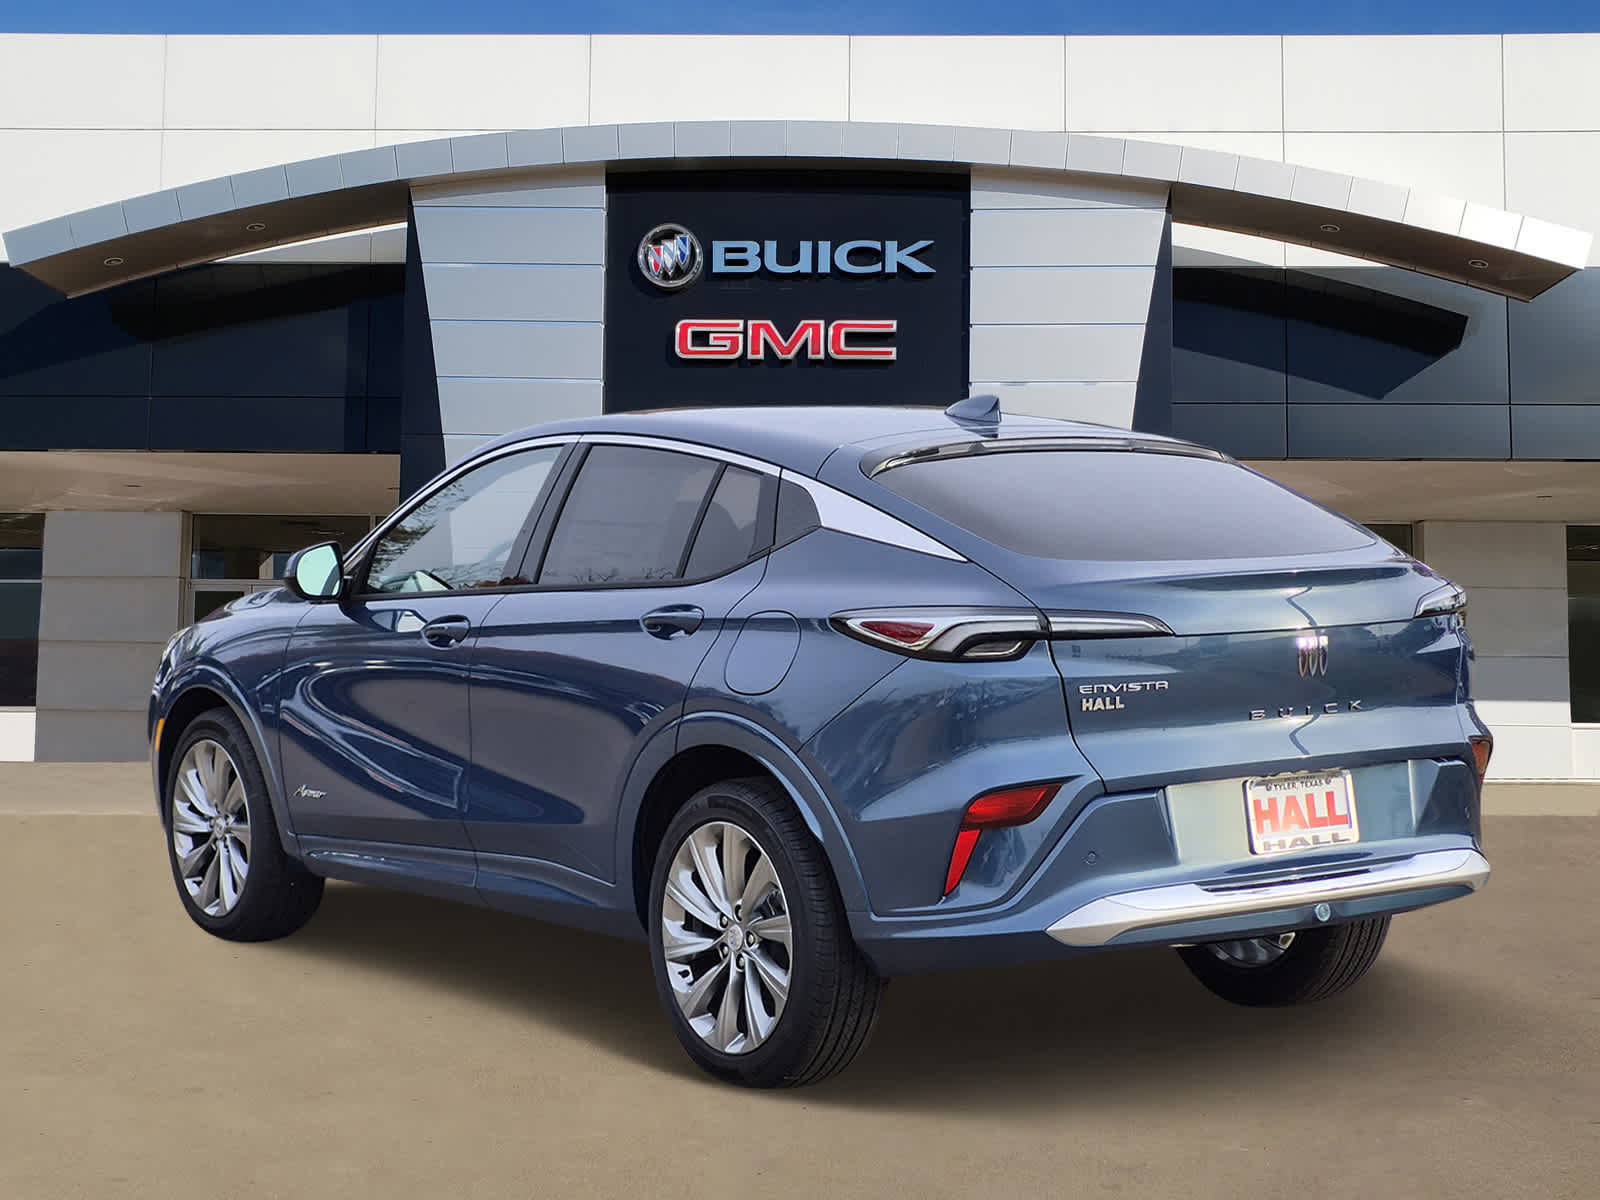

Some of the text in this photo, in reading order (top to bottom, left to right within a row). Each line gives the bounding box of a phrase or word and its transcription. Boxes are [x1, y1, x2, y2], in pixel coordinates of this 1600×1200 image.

[712, 240, 936, 273] BUICK
[674, 319, 897, 360] GMC
[1079, 680, 1168, 694] ENVISTA
[1081, 696, 1125, 711] HALL
[1249, 699, 1362, 720] BUICK
[1300, 779, 1322, 788] TEXAS
[1253, 791, 1348, 834] HALL
[1263, 832, 1350, 851] HALL
